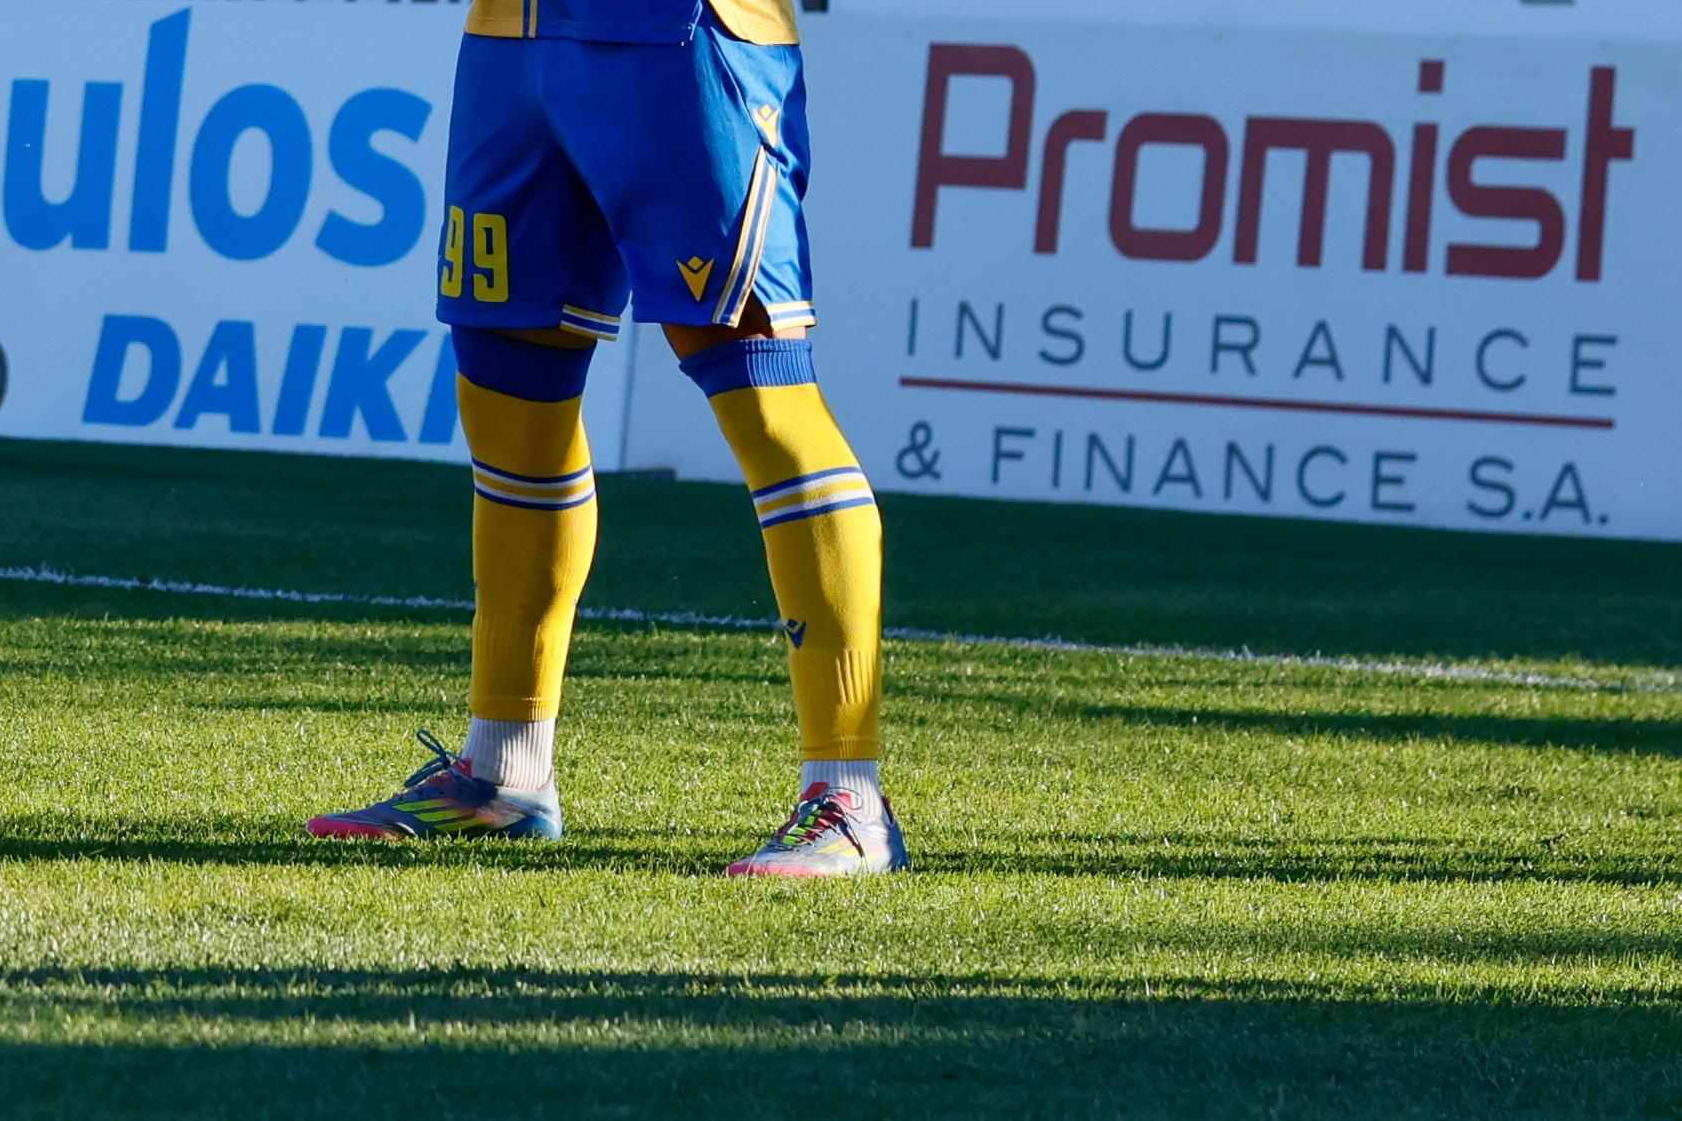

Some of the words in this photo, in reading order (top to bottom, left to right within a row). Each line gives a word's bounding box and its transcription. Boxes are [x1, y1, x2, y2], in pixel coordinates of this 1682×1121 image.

[909, 42, 1636, 282] Promist
[440, 205, 509, 303] 99
[906, 298, 1618, 396] INSURANCE
[897, 421, 942, 480] &
[991, 425, 1418, 511] FINANCE
[1466, 454, 1610, 524] S.A.
